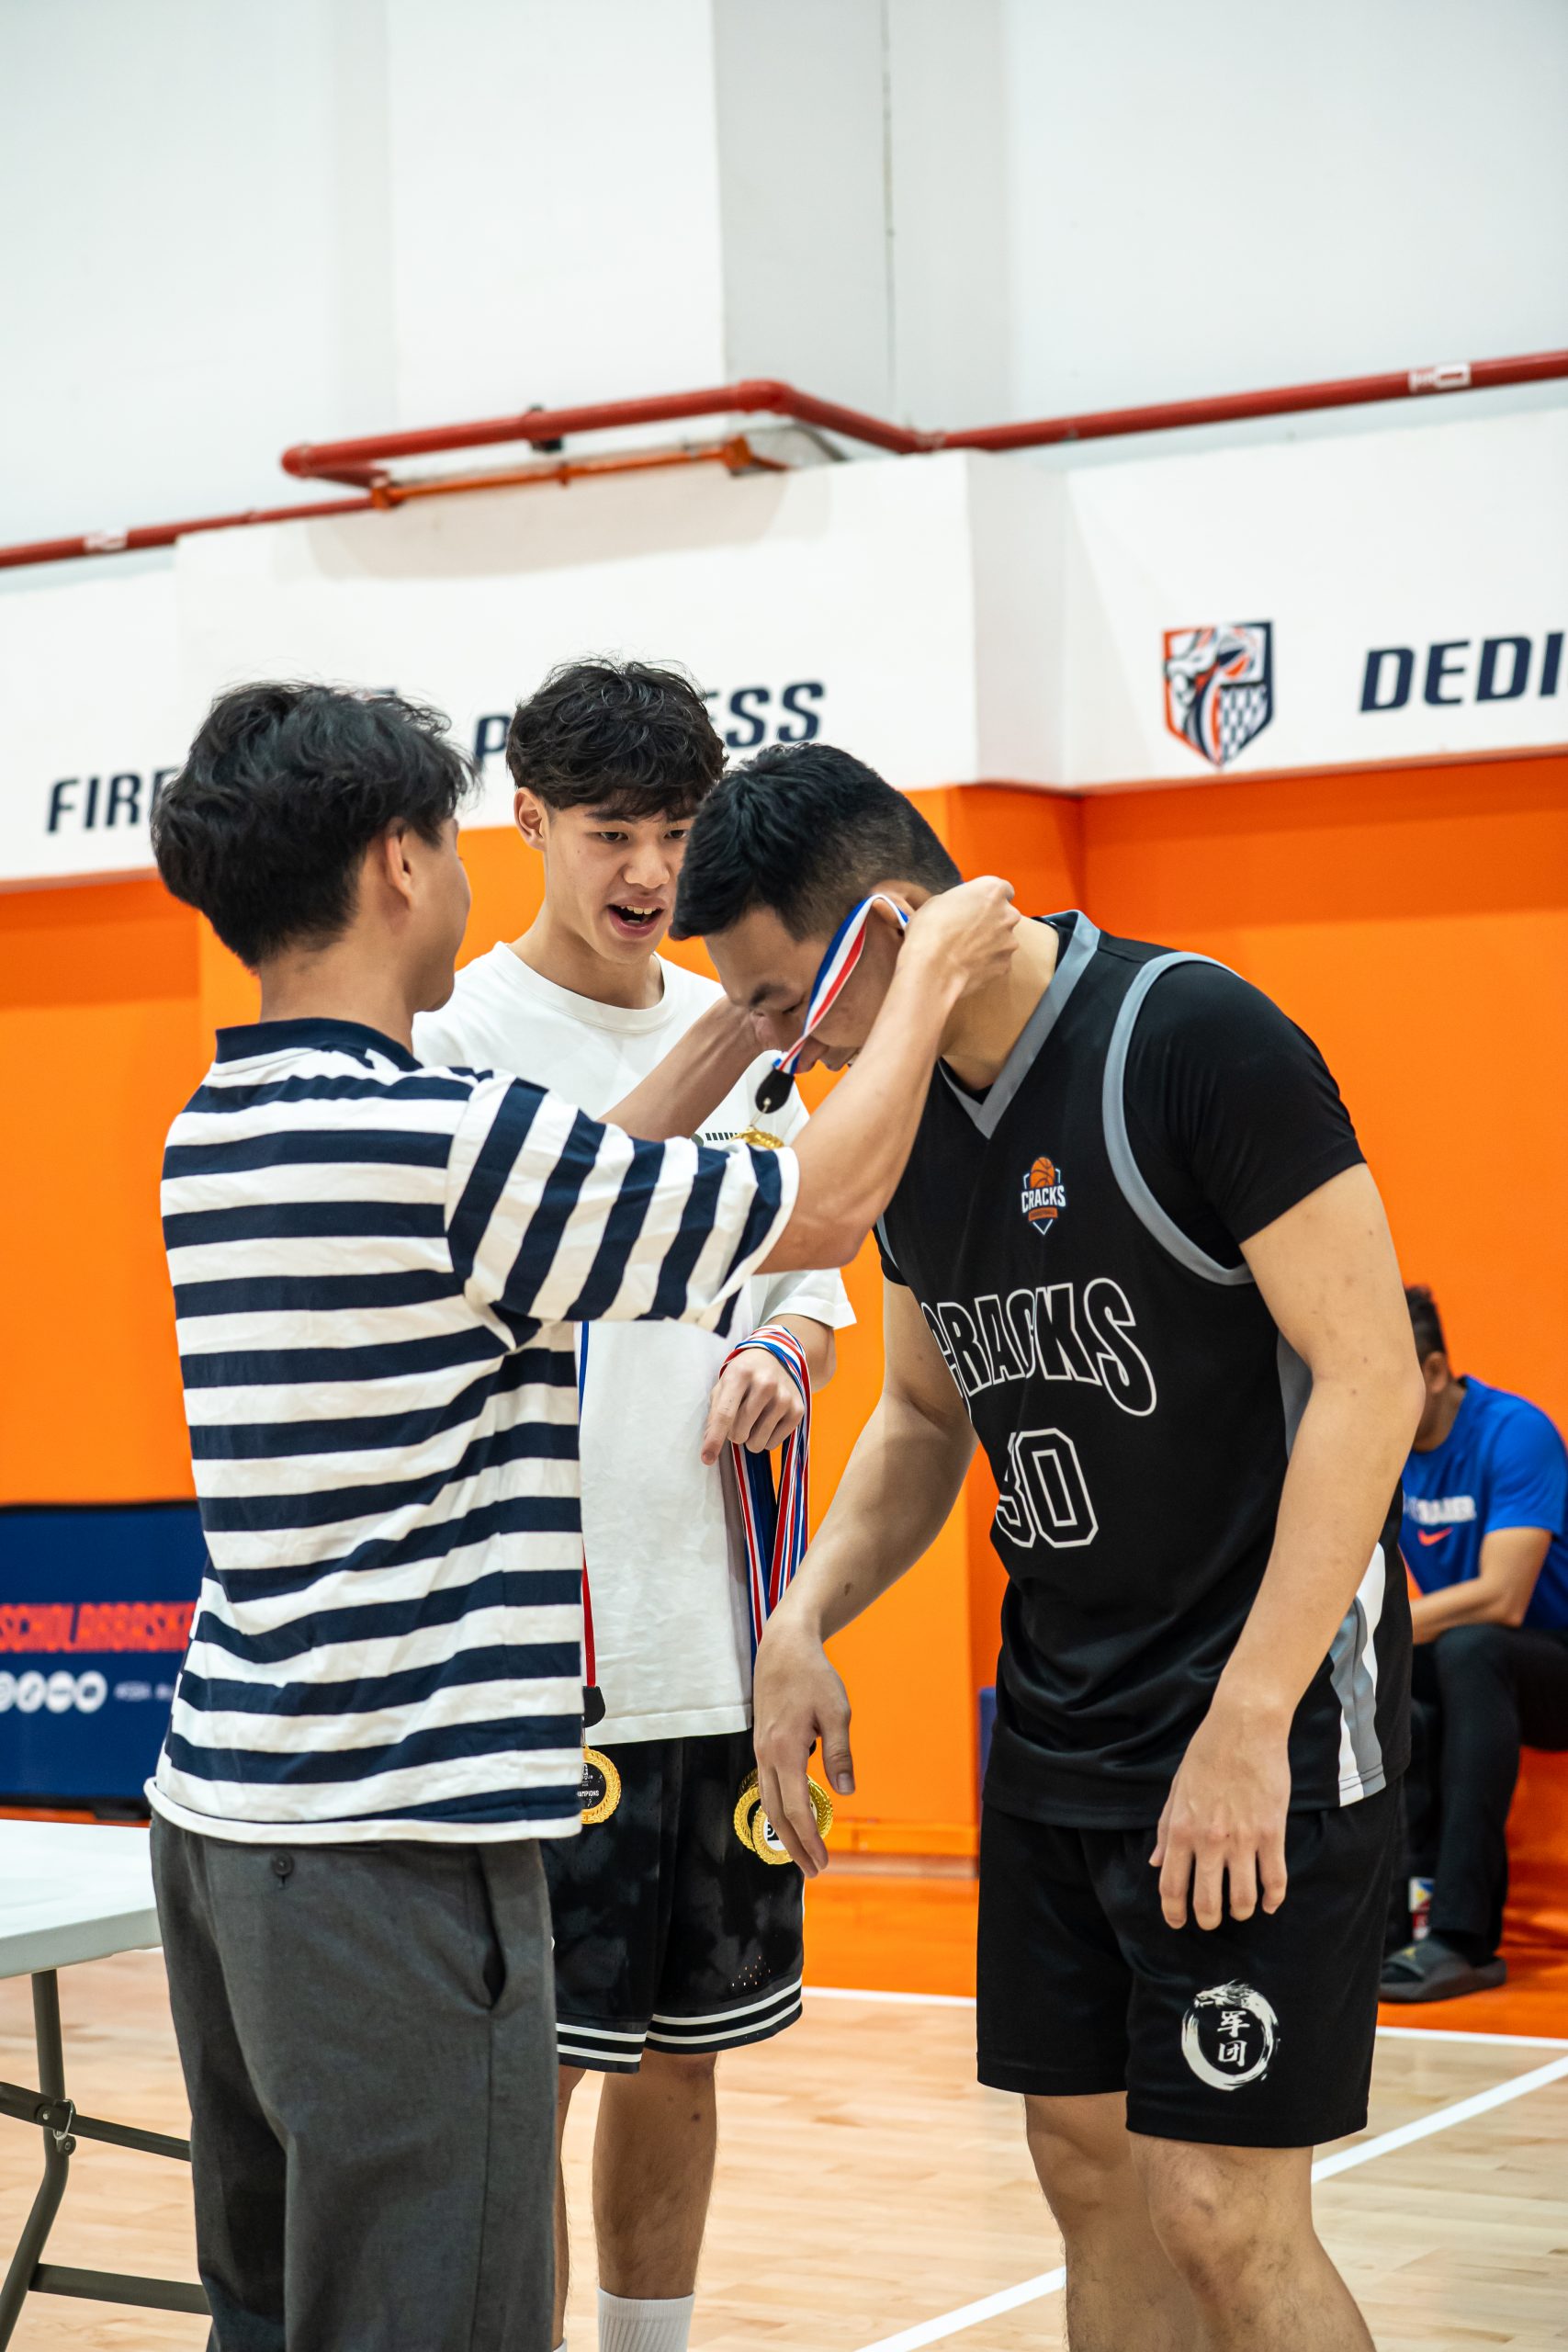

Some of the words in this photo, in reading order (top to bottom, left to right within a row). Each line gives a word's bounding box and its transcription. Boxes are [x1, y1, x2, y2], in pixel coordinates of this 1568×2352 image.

[1359, 630, 1564, 714] DEDI
[1021, 1185, 1066, 1214] CRACKS
[995, 1427, 1100, 1549] 30
[1217, 2009, 1250, 2067] 军团
